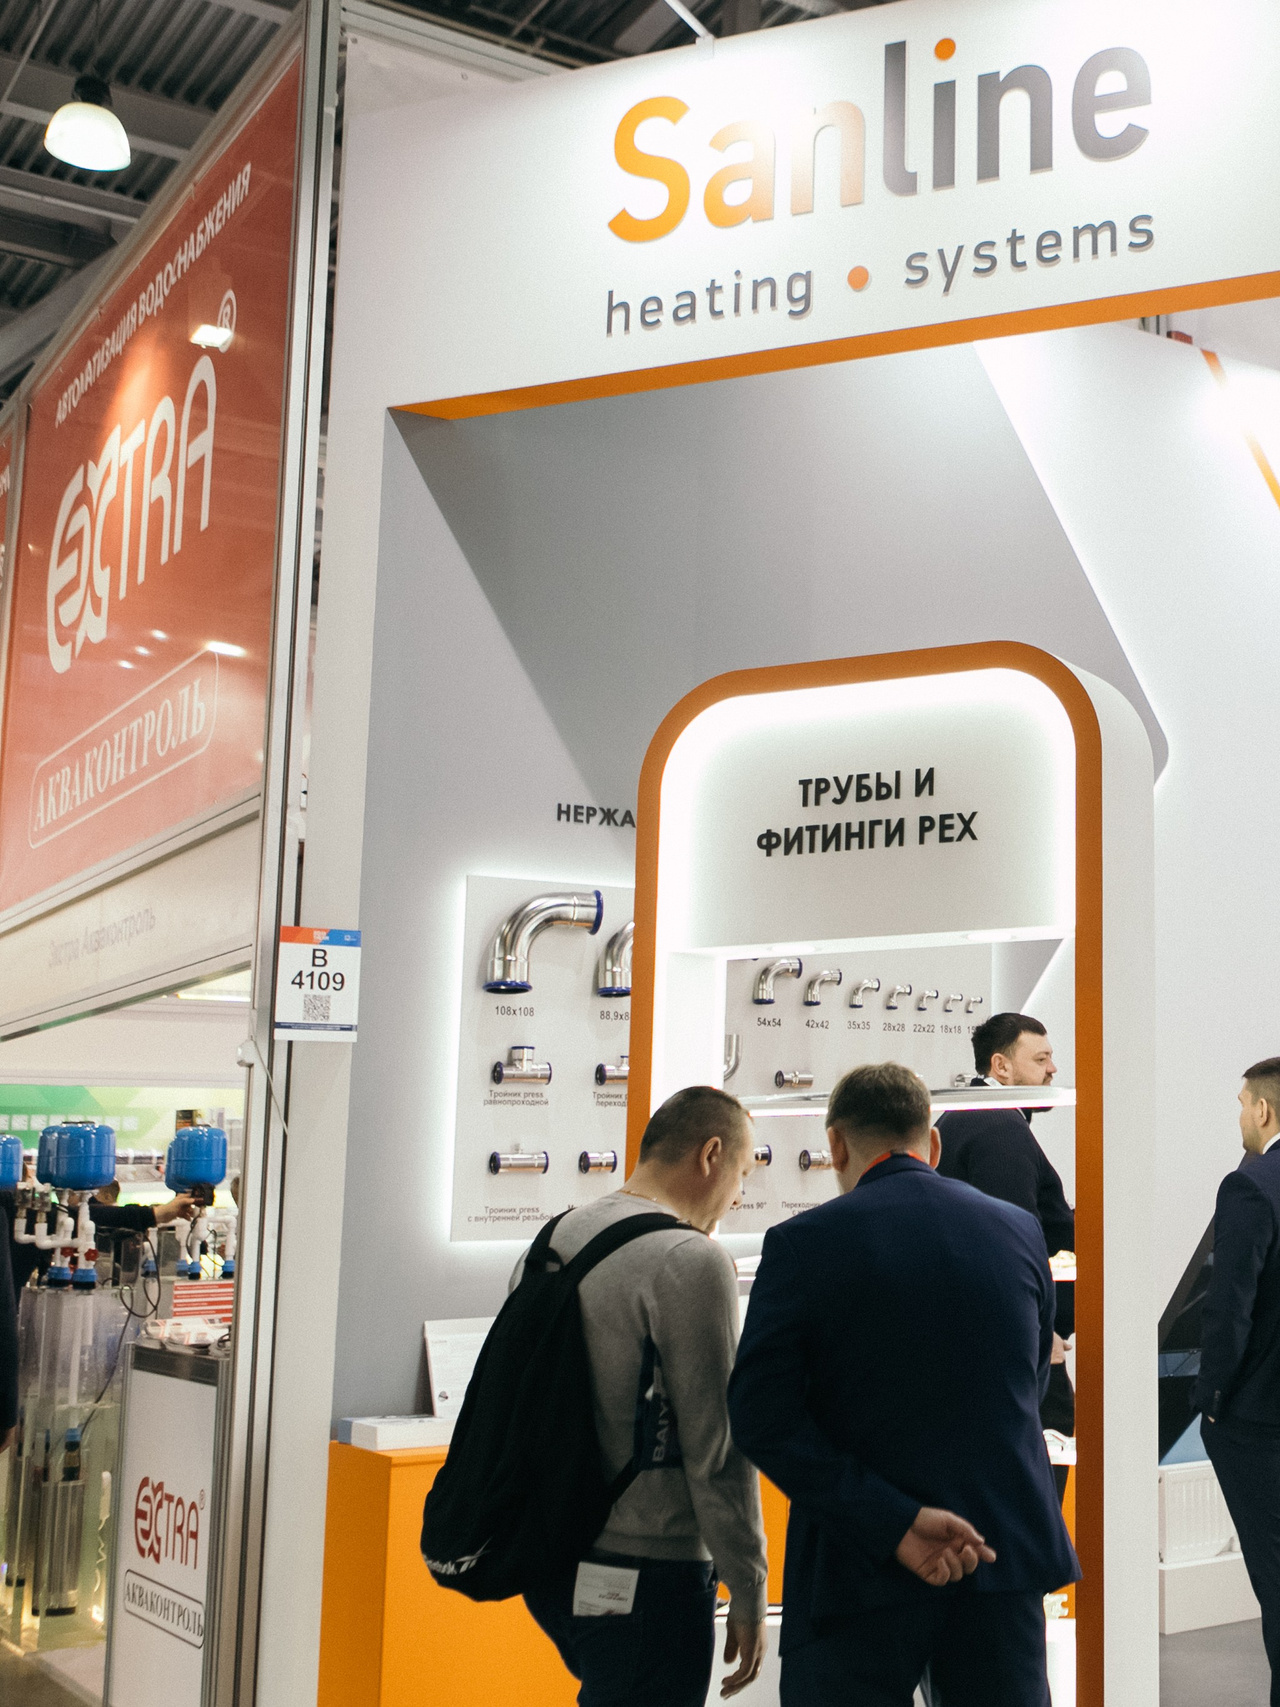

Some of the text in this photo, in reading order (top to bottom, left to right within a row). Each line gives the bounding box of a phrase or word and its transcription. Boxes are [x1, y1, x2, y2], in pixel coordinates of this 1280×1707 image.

[607, 38, 1153, 245] Sanline
[138, 162, 252, 327] ВОДОСНАБЖЕНИЯ
[606, 213, 1155, 338] heating systems
[33, 678, 207, 833] АКВАКОНТРОЛЬ
[798, 767, 935, 807] ТРУБЫ И
[756, 817, 905, 857] ФИТИНГИ
[291, 971, 345, 992] 4109
[125, 1582, 204, 1637] АКВАКОНТРОЛЬ
